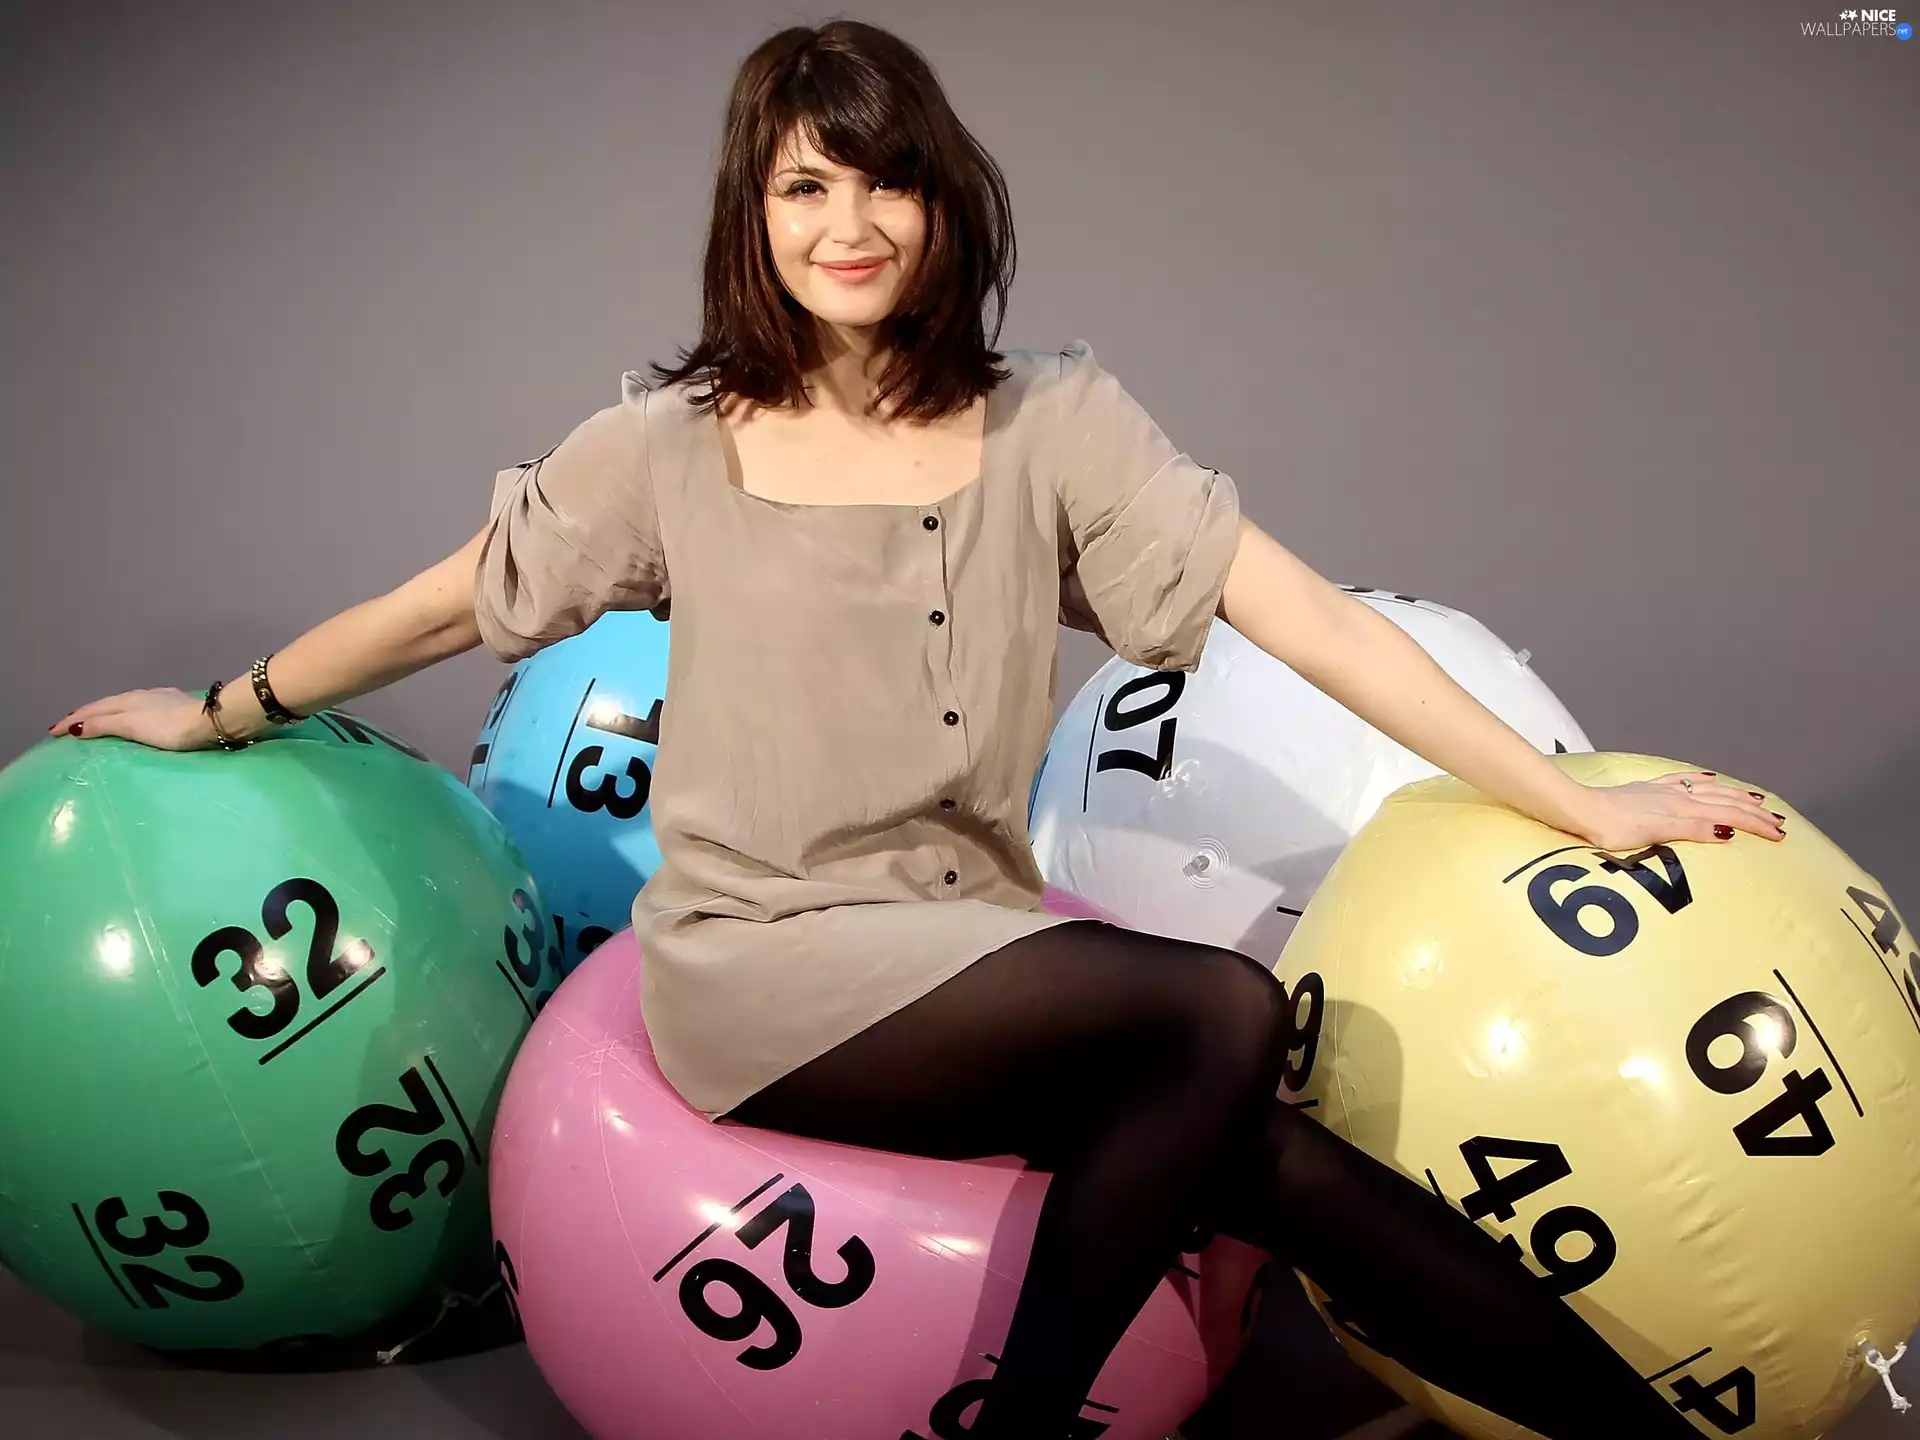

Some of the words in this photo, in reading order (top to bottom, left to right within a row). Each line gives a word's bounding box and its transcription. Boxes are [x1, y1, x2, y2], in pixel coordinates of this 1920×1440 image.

[565, 698, 664, 820] 13
[1096, 671, 1187, 781] 07
[191, 877, 377, 1040] 32
[504, 888, 554, 1013] 3
[1527, 845, 1693, 957] 49
[1281, 972, 1325, 1092] 9
[1685, 991, 1836, 1157] 49
[335, 1066, 466, 1232] 32
[94, 1190, 245, 1309] 32
[678, 1182, 876, 1371] 26
[1459, 1135, 1618, 1298] 49
[1669, 1366, 1756, 1435] 4
